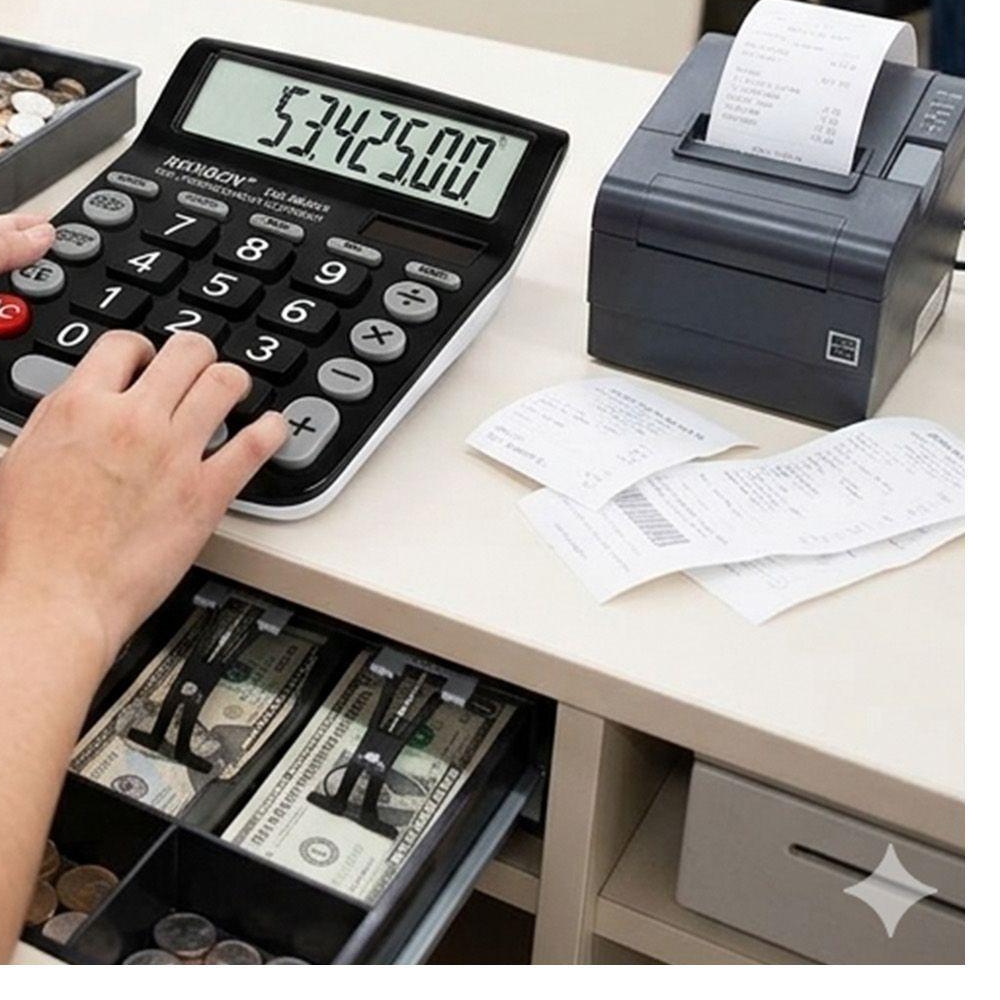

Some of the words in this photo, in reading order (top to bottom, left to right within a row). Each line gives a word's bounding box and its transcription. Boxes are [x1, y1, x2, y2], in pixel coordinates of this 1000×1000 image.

[164, 212, 197, 236] 7
[236, 237, 270, 262] 8
[127, 252, 161, 273] 4
[314, 261, 347, 285] 9
[202, 272, 239, 297] 5
[99, 286, 122, 309] 1
[164, 310, 202, 333] 2
[281, 299, 316, 323] 6
[57, 322, 90, 347] 0
[245, 336, 280, 361] 3
